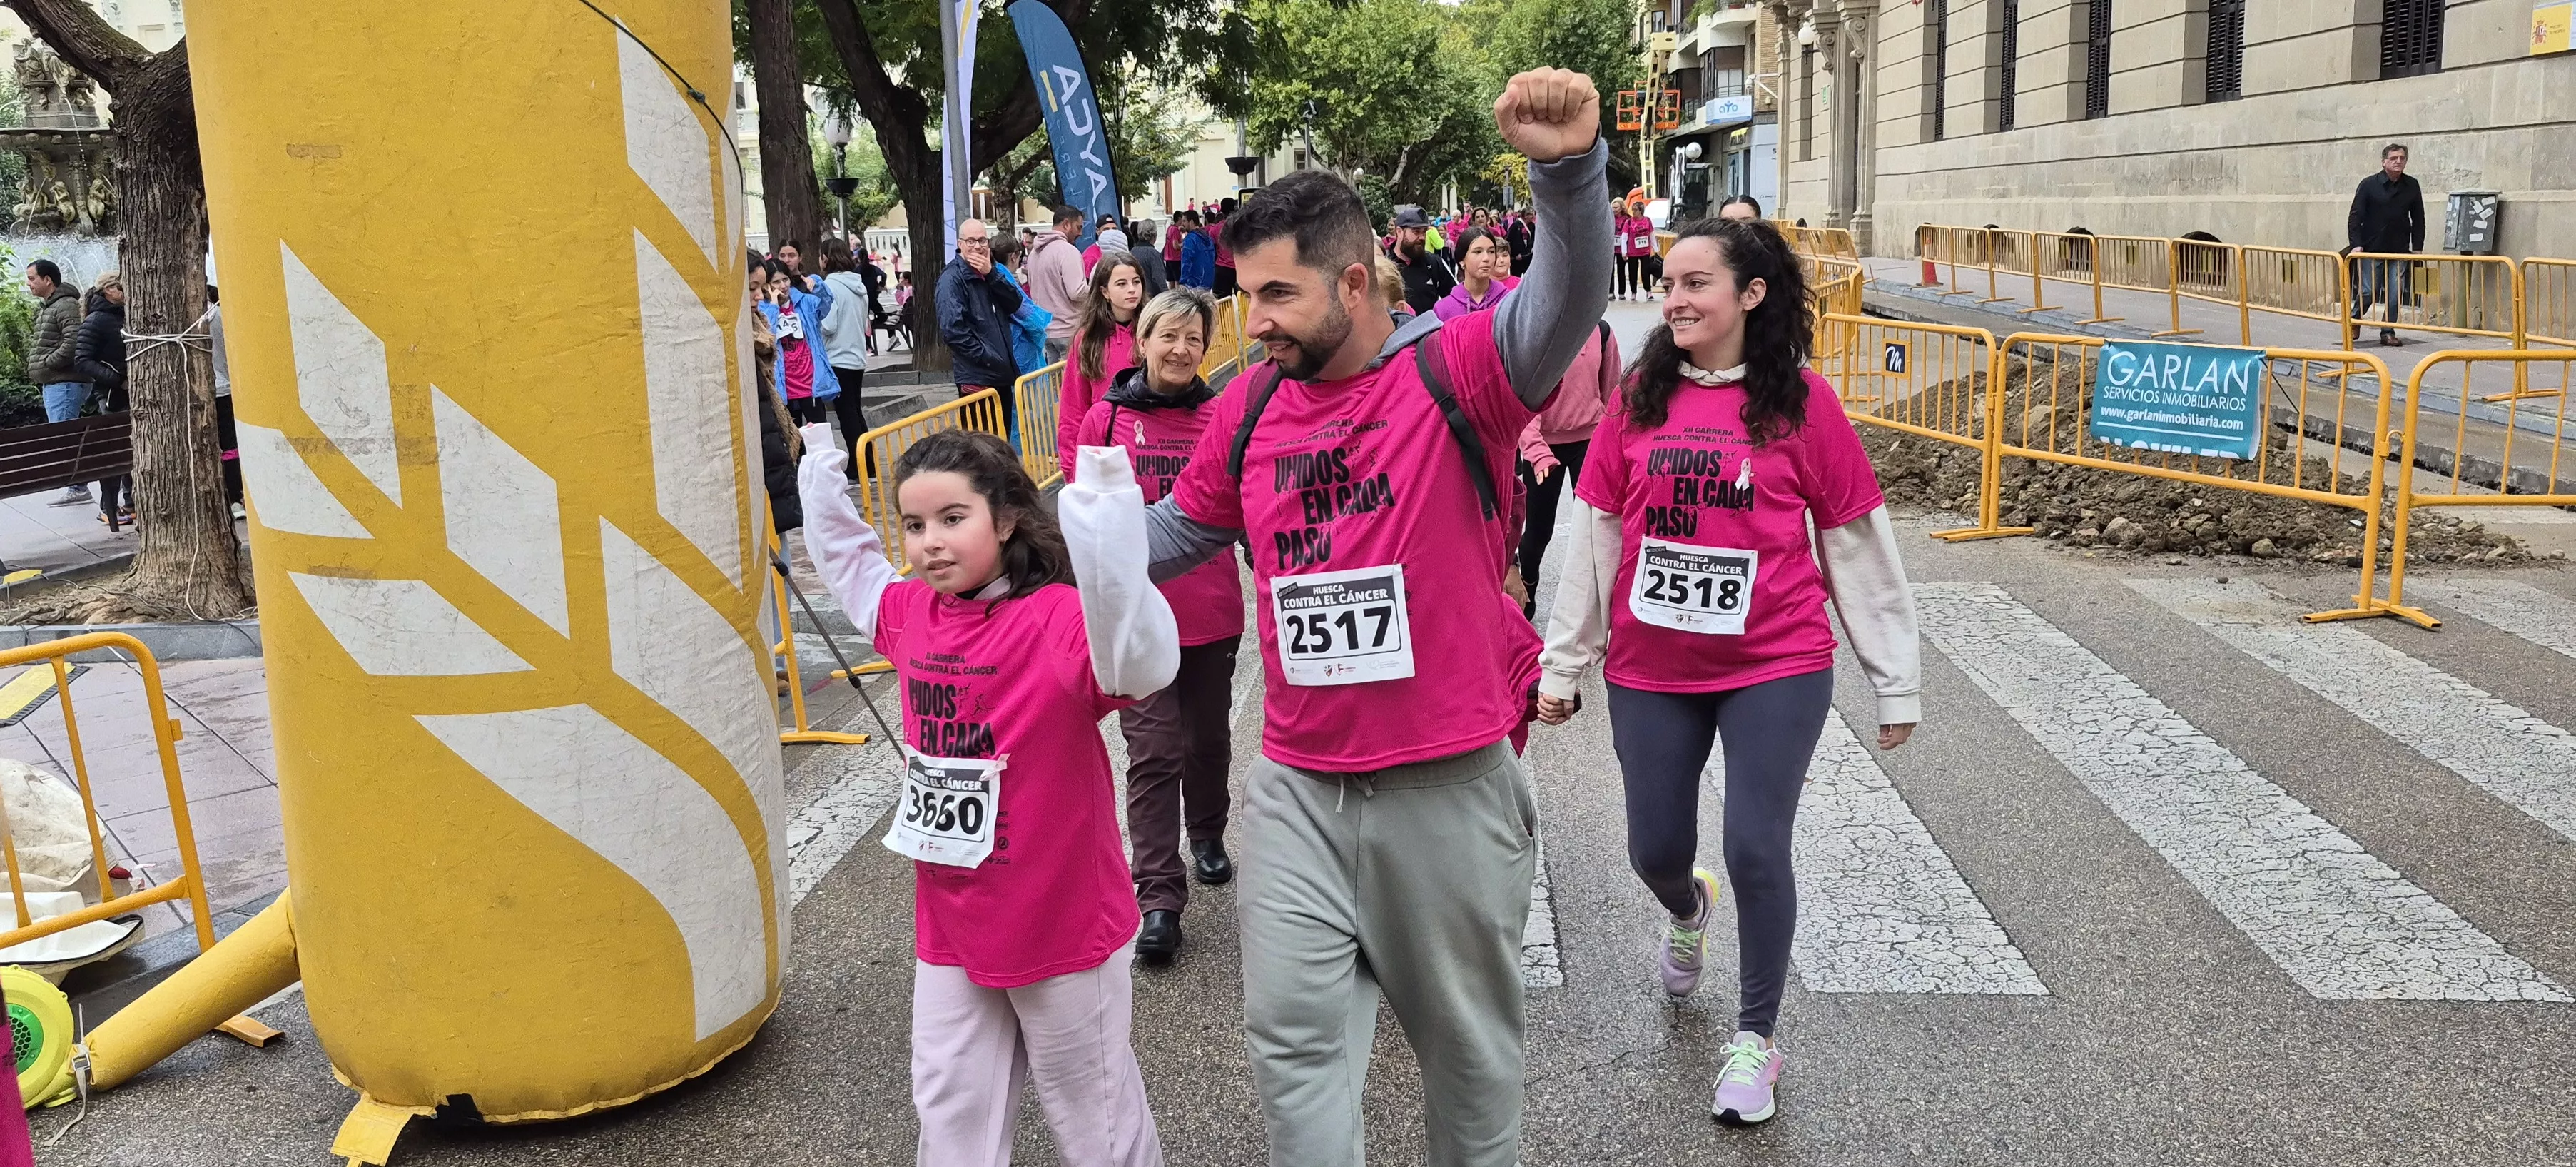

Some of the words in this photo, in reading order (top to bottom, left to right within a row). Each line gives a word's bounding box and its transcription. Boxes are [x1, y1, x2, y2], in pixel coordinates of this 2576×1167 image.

[2107, 350, 2251, 395] GARLAN
[2104, 386, 2160, 404] SERVICIOS
[2162, 391, 2246, 412] INMOBILIARIOS
[1695, 428, 1733, 436] CARRERA
[2101, 405, 2243, 430] www.garlaninmobiliaria.com
[1684, 435, 1716, 443] CONTRA
[1731, 436, 1753, 445] CÁNC
[1274, 447, 1350, 494] UNIDOS
[1647, 448, 1723, 478] UNIDOS
[1301, 487, 1334, 525] EN
[1336, 473, 1396, 517] CADA
[1673, 477, 1699, 506] EN
[1703, 479, 1755, 512] CADA
[1646, 506, 1698, 538] PASO
[1274, 527, 1332, 570] PASO
[1680, 554, 1709, 563] HUESCA
[1650, 555, 1686, 570] CONTRA
[1702, 562, 1743, 575] CÁNCER
[1284, 597, 1322, 609] CONTRA
[1324, 596, 1337, 605] EL
[1339, 588, 1389, 605] CÁNCER
[1313, 584, 1344, 595] HUESCA
[1643, 569, 1741, 610] 2518
[1286, 605, 1392, 655] 2517
[950, 665, 961, 675] EL
[963, 665, 998, 675] CÁNCER
[920, 718, 940, 755] EN
[942, 722, 995, 757] CADA
[930, 777, 941, 787] EL
[941, 777, 983, 790] CÁNCER
[906, 784, 983, 835] 3660
